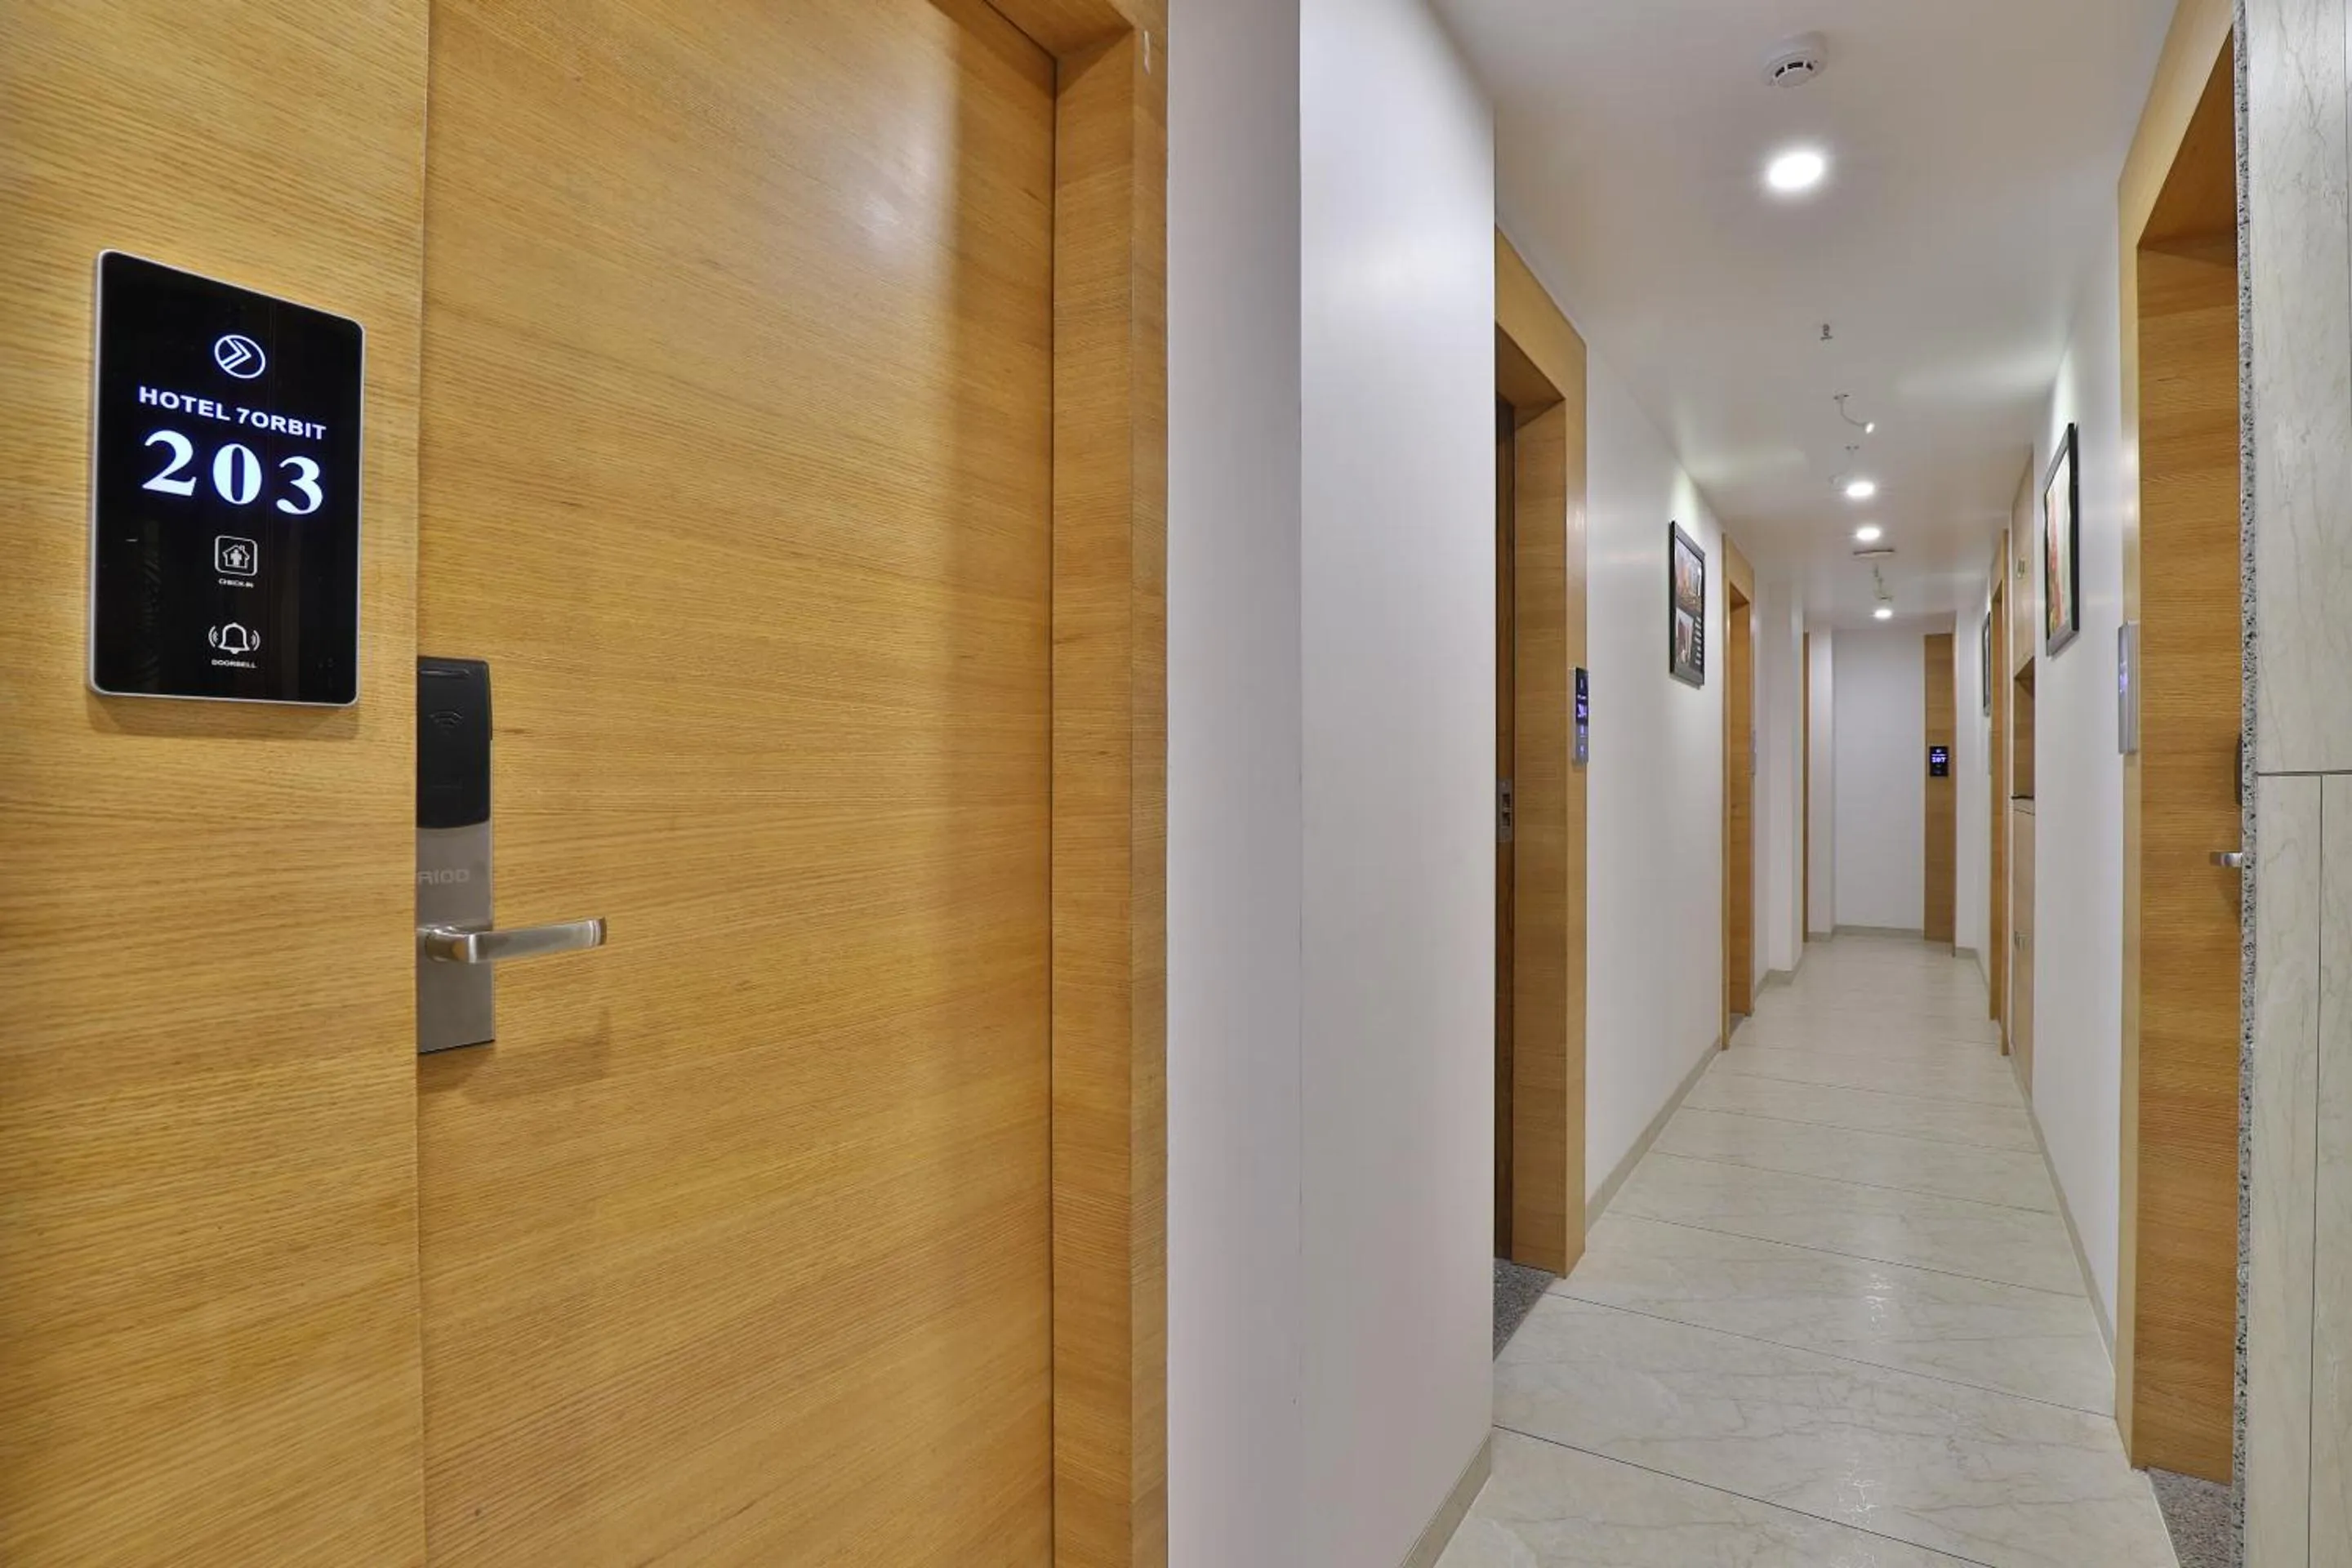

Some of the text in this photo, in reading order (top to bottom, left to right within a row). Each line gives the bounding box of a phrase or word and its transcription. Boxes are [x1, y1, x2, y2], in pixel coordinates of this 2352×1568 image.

[138, 385, 327, 440] HOTEL 7ORBIT
[141, 429, 324, 515] 203
[211, 659, 256, 669] DOORBELL
